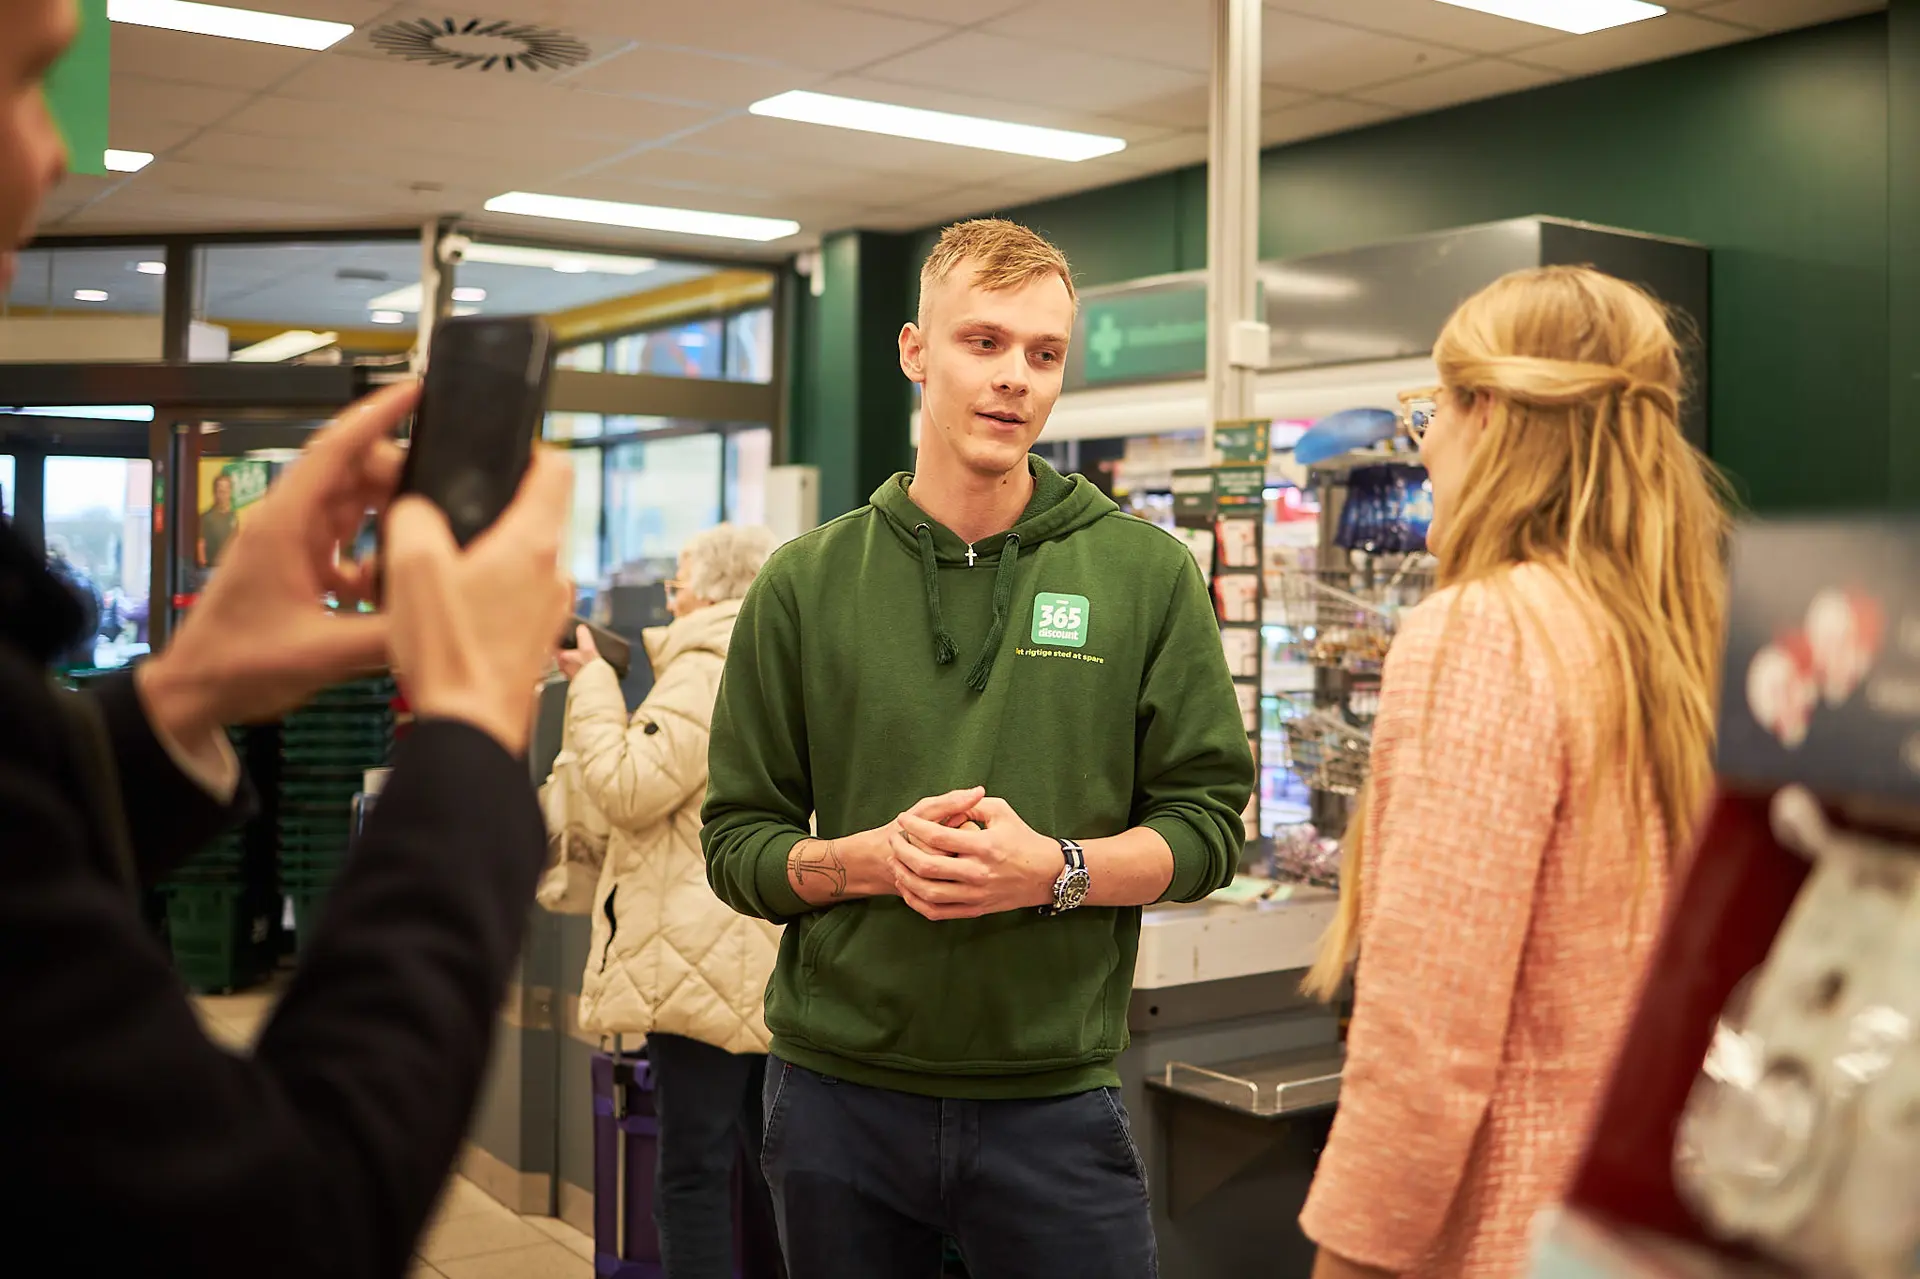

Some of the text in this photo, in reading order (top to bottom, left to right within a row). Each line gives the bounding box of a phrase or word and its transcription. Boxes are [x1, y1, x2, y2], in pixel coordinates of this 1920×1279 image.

[1039, 605, 1082, 630] 365
[1038, 628, 1079, 641] discount
[1025, 648, 1053, 657] rigtige
[1053, 650, 1072, 658] sted
[1072, 652, 1082, 660] at
[1082, 654, 1104, 664] spare
